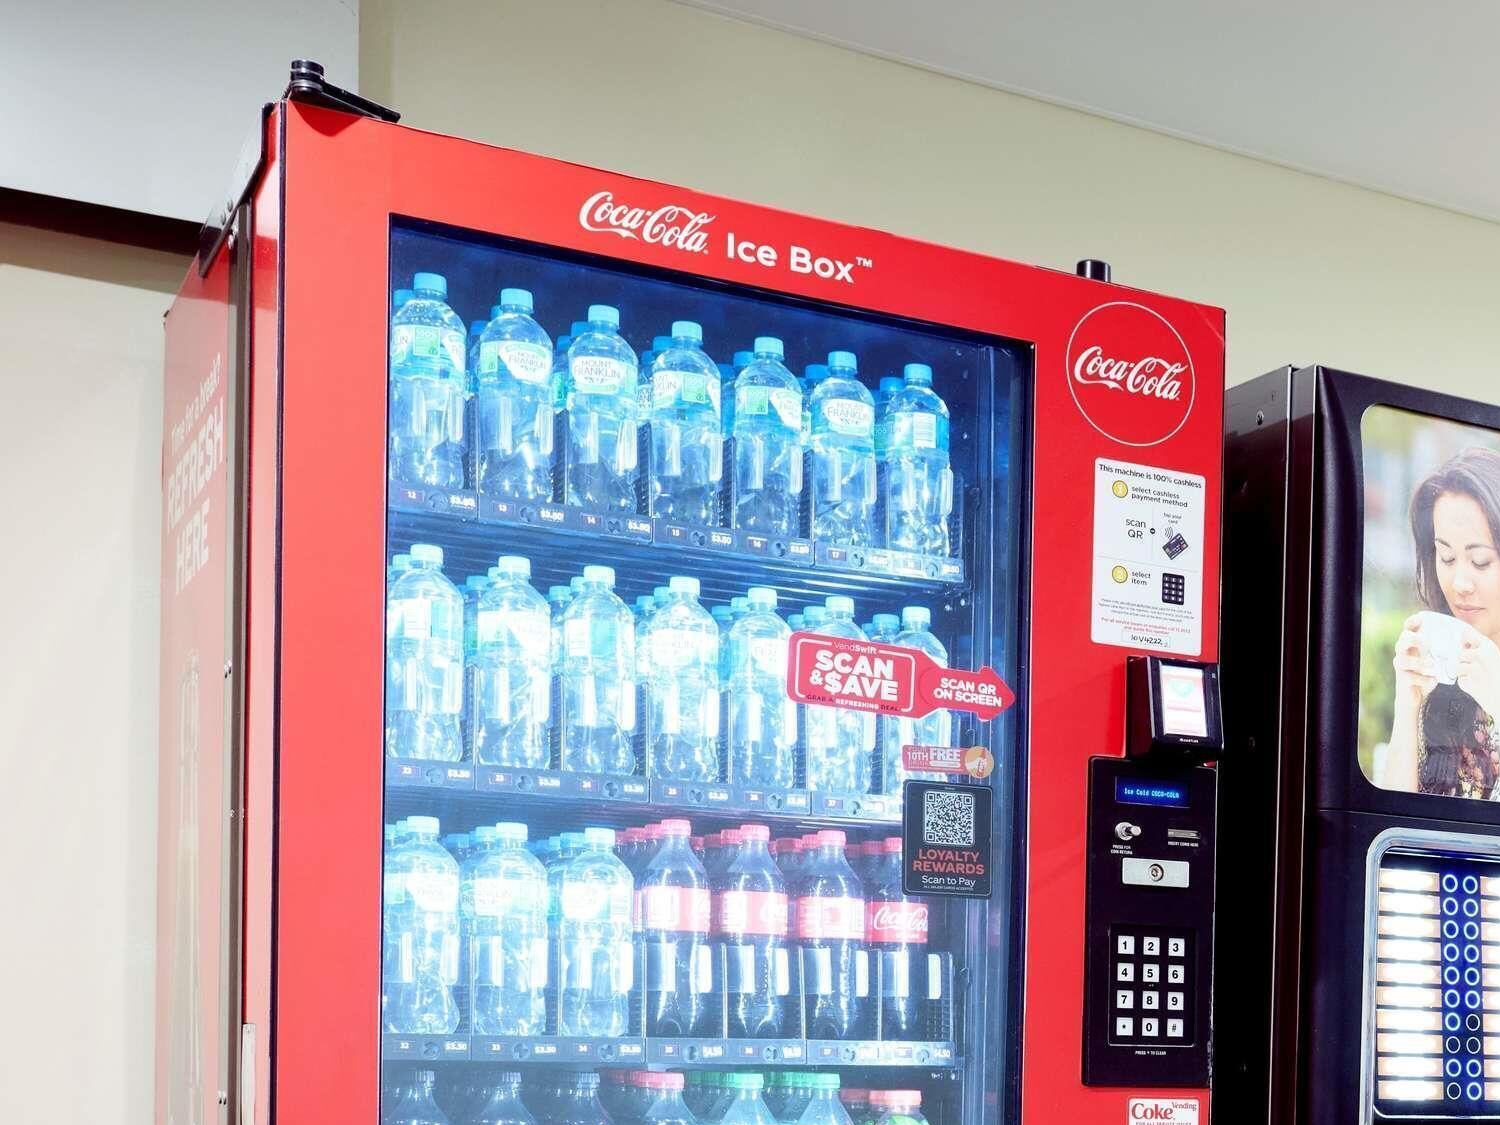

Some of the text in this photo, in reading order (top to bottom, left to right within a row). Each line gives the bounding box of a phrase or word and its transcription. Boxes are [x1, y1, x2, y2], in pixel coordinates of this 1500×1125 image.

[579, 191, 716, 254] Coca-Cola
[727, 232, 778, 267] Ice
[574, 366, 621, 379] FRANKLIN
[1074, 345, 1188, 401] Coca-Cola
[167, 396, 224, 533] REFRESH
[1099, 464, 1113, 473] This
[1115, 466, 1145, 479] machine
[1153, 473, 1172, 483] 100%
[1173, 477, 1202, 488] cashless
[1131, 485, 1180, 499] select cashless
[1131, 493, 1188, 508] payment method
[1125, 519, 1146, 528] scan
[1127, 529, 1144, 540] QR
[175, 495, 210, 596] HERE
[1131, 570, 1151, 579] select
[1131, 578, 1148, 586] item
[815, 649, 894, 680] SCAN
[940, 677, 996, 695] SCAN QR
[933, 687, 1002, 707] ON SCREEN
[836, 698, 879, 710] REFRESHING
[907, 751, 929, 761] 10TH
[929, 747, 961, 761] FREE
[1124, 787, 1134, 795] Ice
[918, 848, 980, 864] LOYALTY
[912, 861, 985, 876] REWARDS
[921, 875, 976, 888] Scan to Pay
[1122, 941, 1128, 950] 1
[1148, 942, 1154, 951] 2
[1173, 943, 1179, 952] 3
[1121, 967, 1128, 977] 4
[1147, 968, 1153, 978] 5
[1172, 970, 1178, 979] 6
[1121, 995, 1128, 1004] 7
[1147, 996, 1153, 1005] 8
[1172, 997, 1178, 1006] 9
[1146, 1022, 1153, 1032] 0
[1132, 1101, 1198, 1120] Coke Vending
